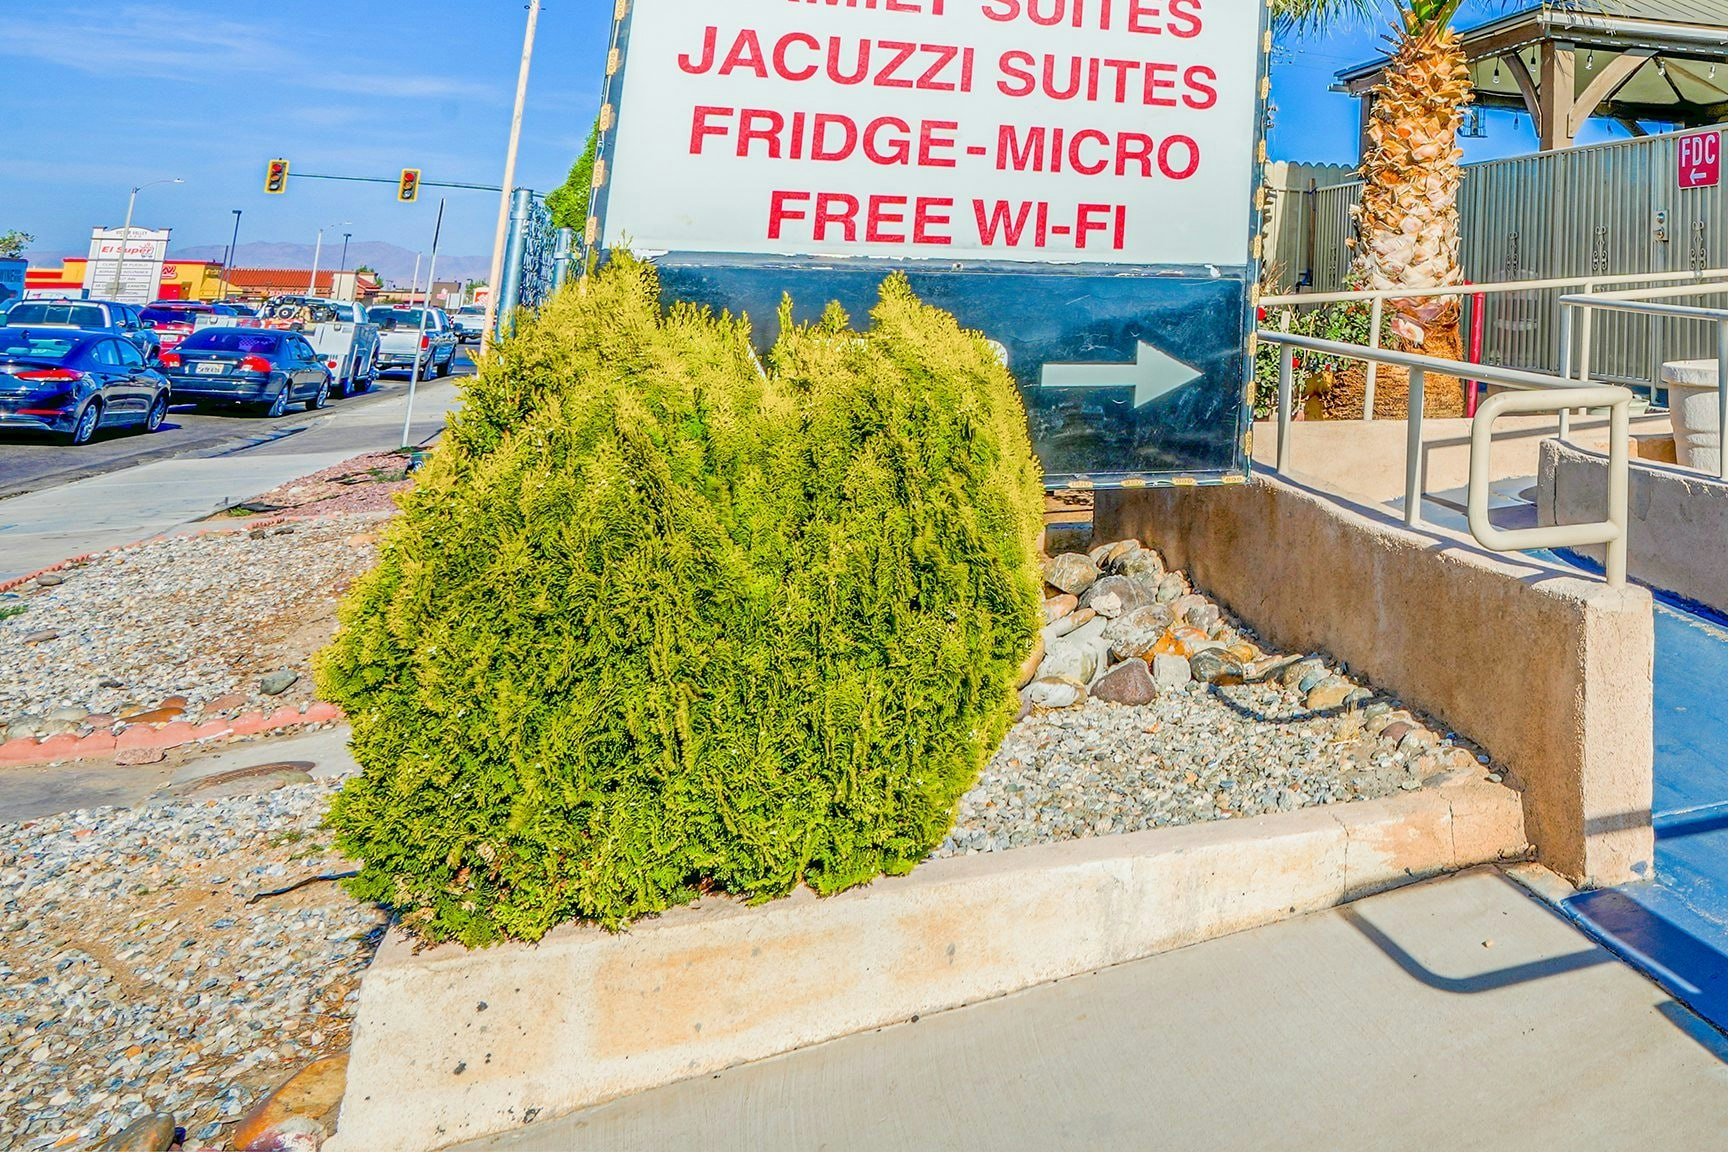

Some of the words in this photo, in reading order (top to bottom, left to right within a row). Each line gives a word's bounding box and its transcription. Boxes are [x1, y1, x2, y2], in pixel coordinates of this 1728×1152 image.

[677, 25, 974, 93] JACUZZI
[996, 50, 1218, 110] SUITES
[688, 105, 1200, 181] FRIDGE-MICRO
[1681, 134, 1716, 168] FDC
[101, 245, 113, 254] El
[116, 245, 151, 255] Super
[766, 190, 952, 246] FREE
[972, 198, 1126, 250] WI-FI
